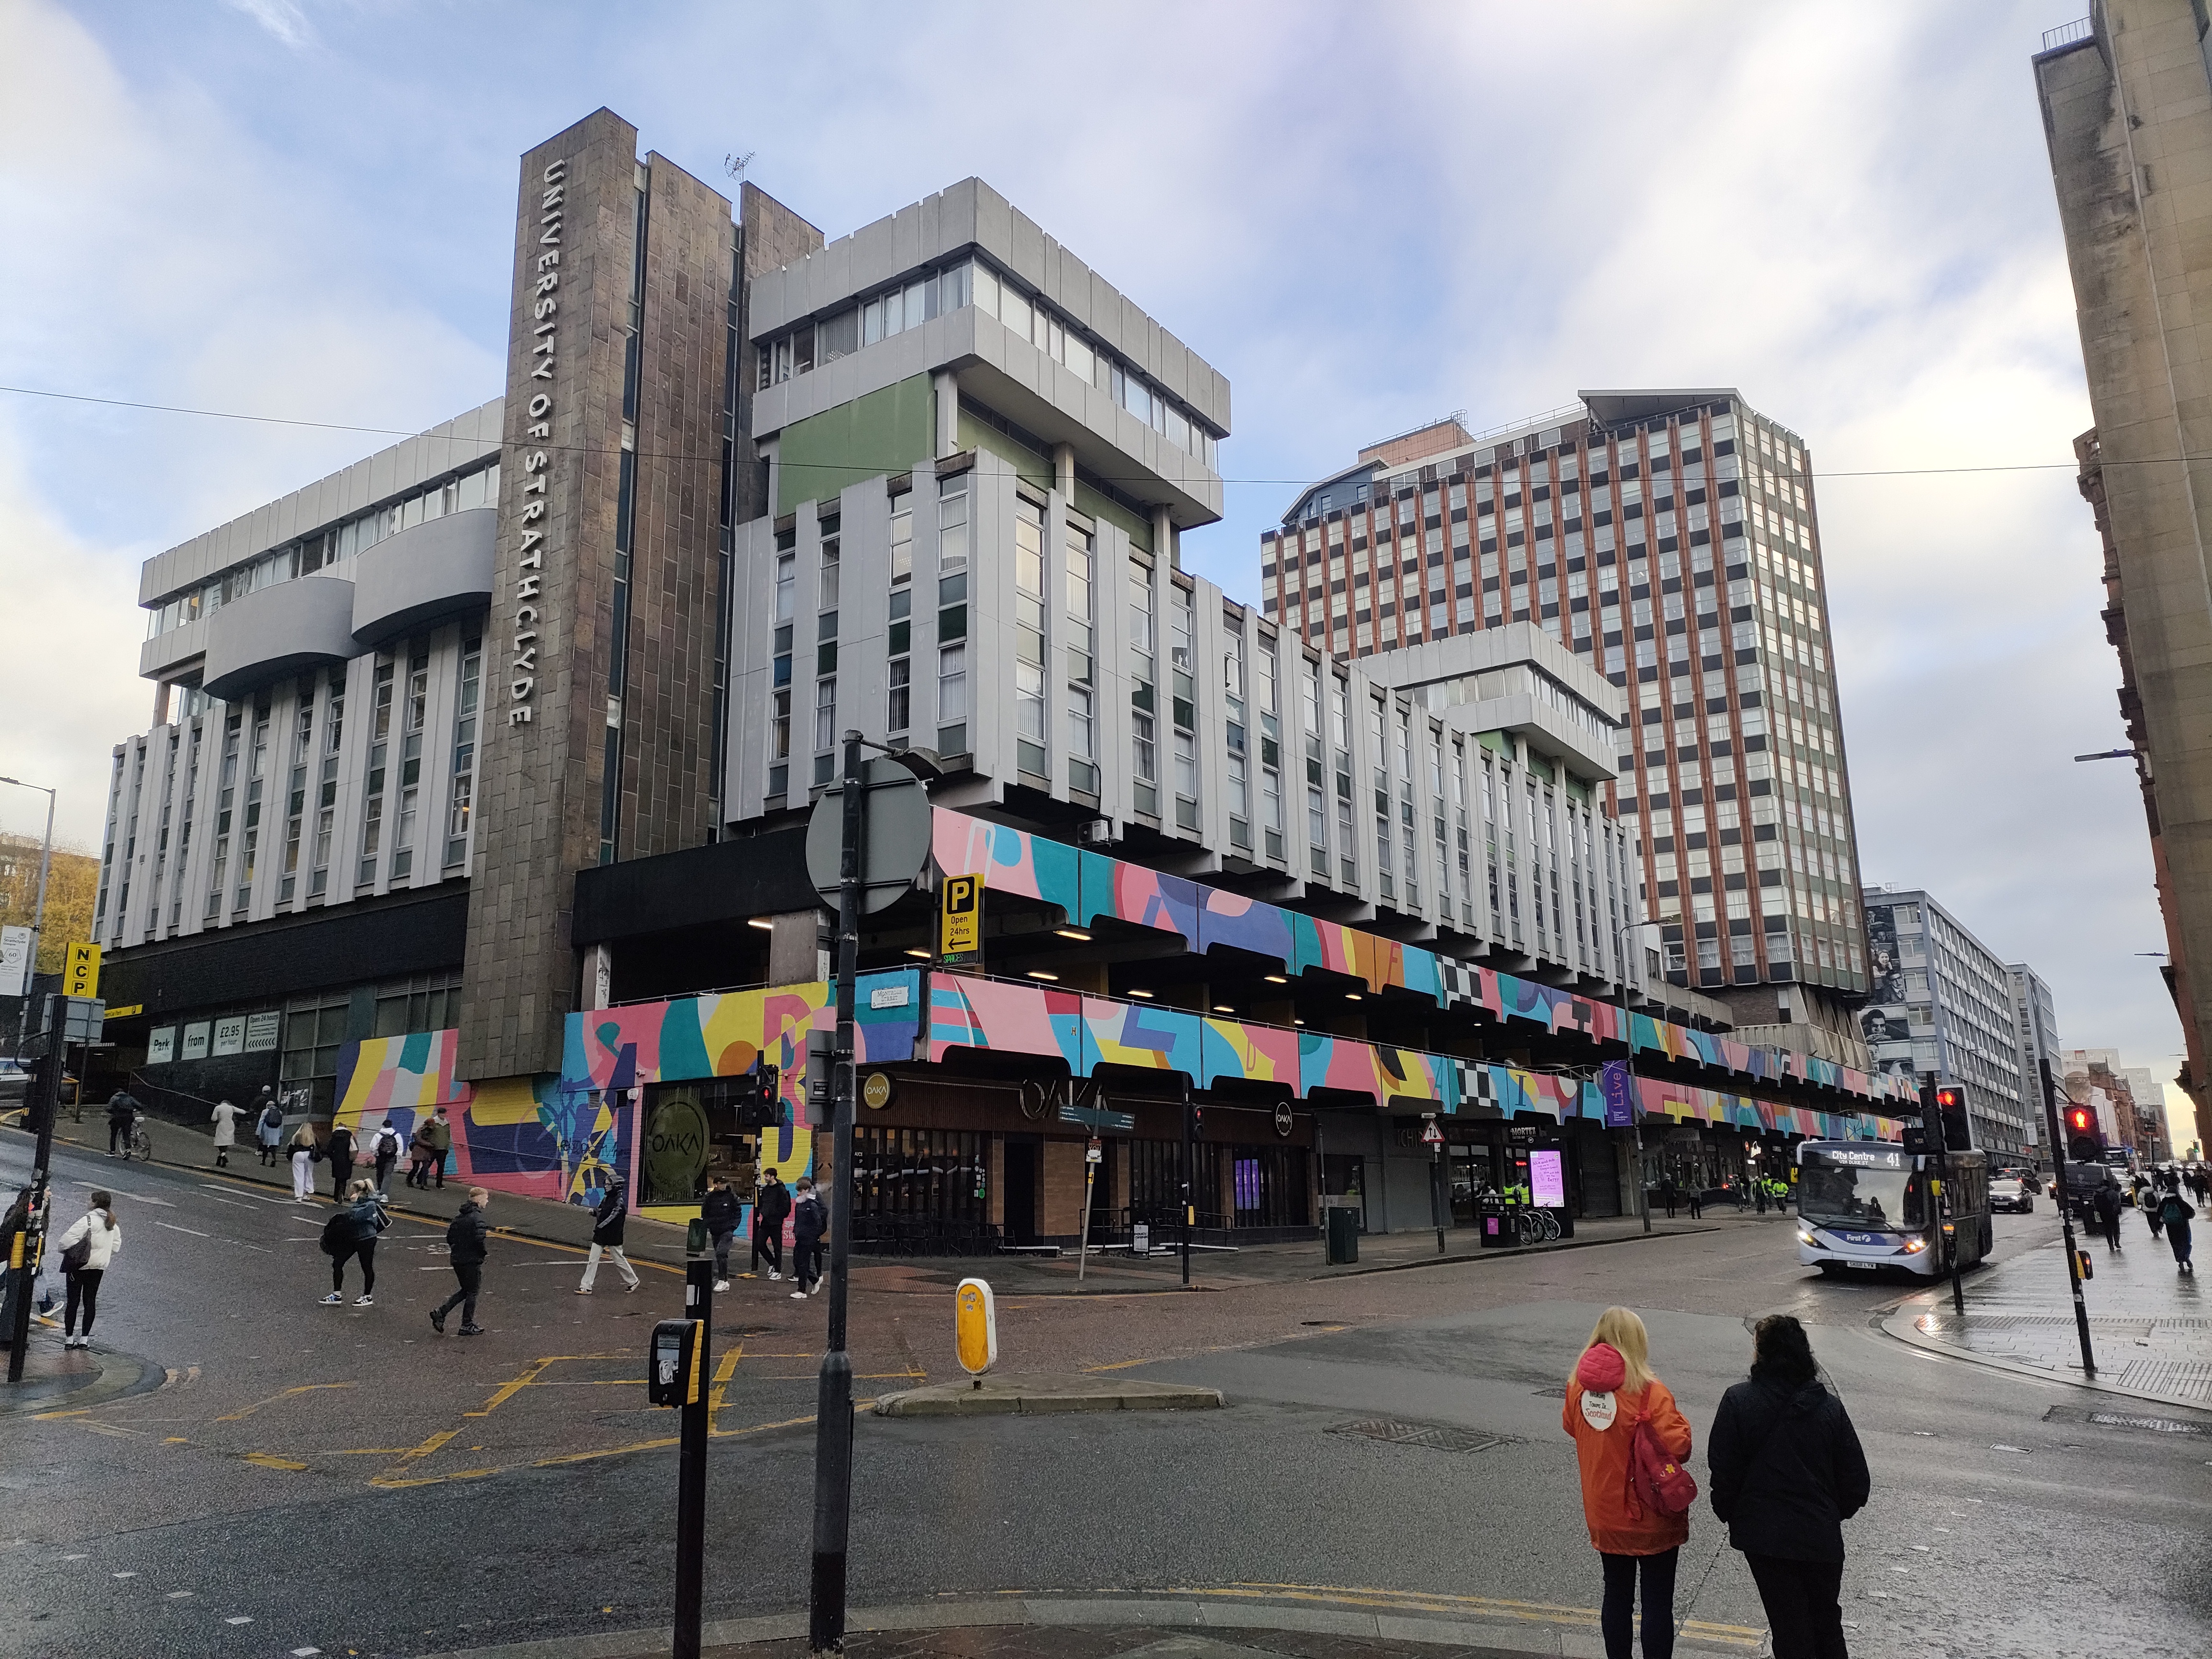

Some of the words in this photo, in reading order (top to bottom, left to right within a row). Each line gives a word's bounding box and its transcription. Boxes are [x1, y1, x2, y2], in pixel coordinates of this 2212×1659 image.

[531, 159, 565, 379] UNIVERSITY
[528, 393, 551, 438] OF
[509, 451, 548, 727] STRATHCLYDE
[952, 881, 969, 911] P
[951, 916, 968, 926] Open
[950, 927, 970, 936] 24hrs
[943, 953, 964, 964] SPACES
[74, 949, 90, 994] NCP
[220, 1025, 240, 1038] £2.95
[154, 1039, 170, 1052] Park
[188, 1035, 204, 1047] from
[866, 1085, 887, 1095] OAKA
[1611, 1073, 1624, 1106] Live
[1277, 1114, 1291, 1124] OAKA
[1510, 1127, 1536, 1136] MORTEZ
[652, 1133, 699, 1156] OAKA
[1832, 1151, 1847, 1160] City
[1849, 1151, 1875, 1161] Centre
[1887, 1152, 1901, 1167] 41
[1589, 1401, 1601, 1409] Tours
[1585, 1408, 1612, 1420] Scotland
